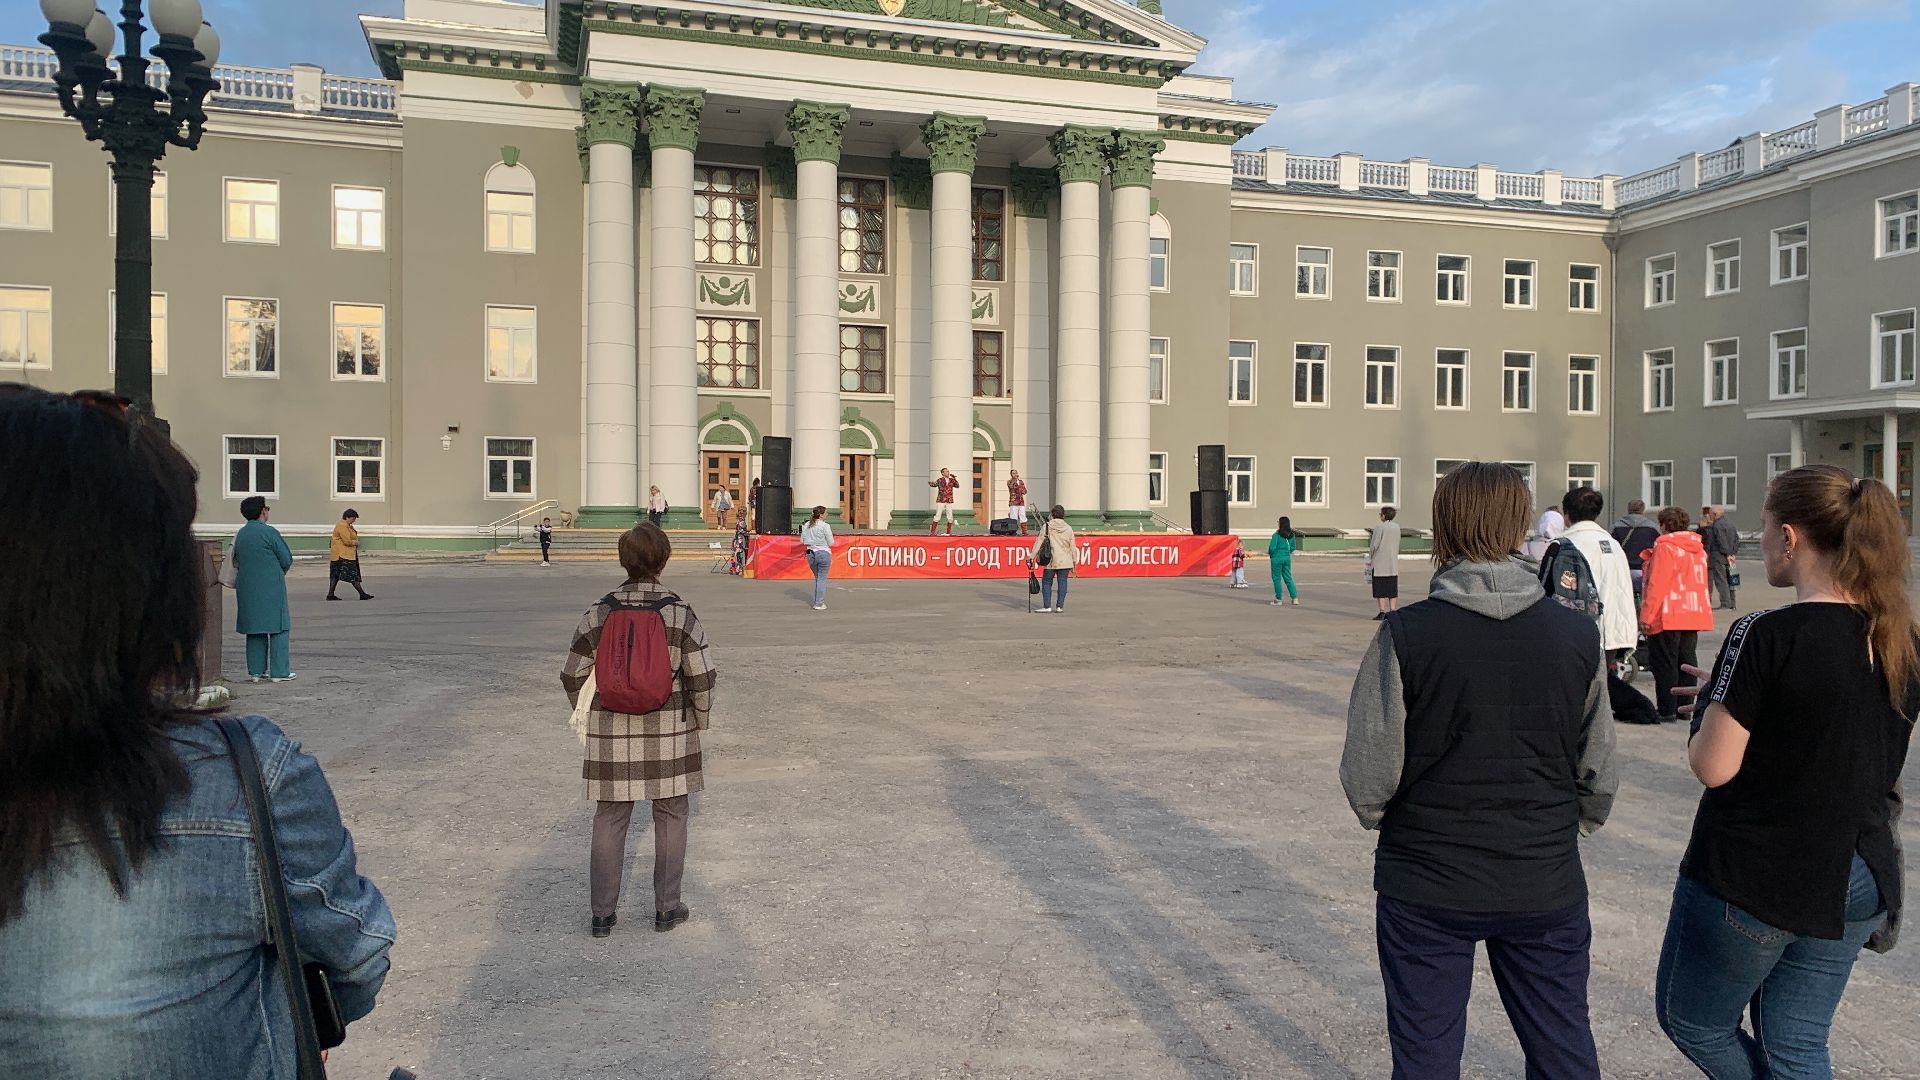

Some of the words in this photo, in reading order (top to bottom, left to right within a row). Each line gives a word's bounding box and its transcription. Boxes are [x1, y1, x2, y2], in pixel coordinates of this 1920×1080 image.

[847, 546, 926, 567] СТУПИНО
[945, 546, 1001, 569] ГОРОД
[1096, 546, 1179, 569] ДОБЛЕСТИ
[1733, 610, 1764, 641] HANEL
